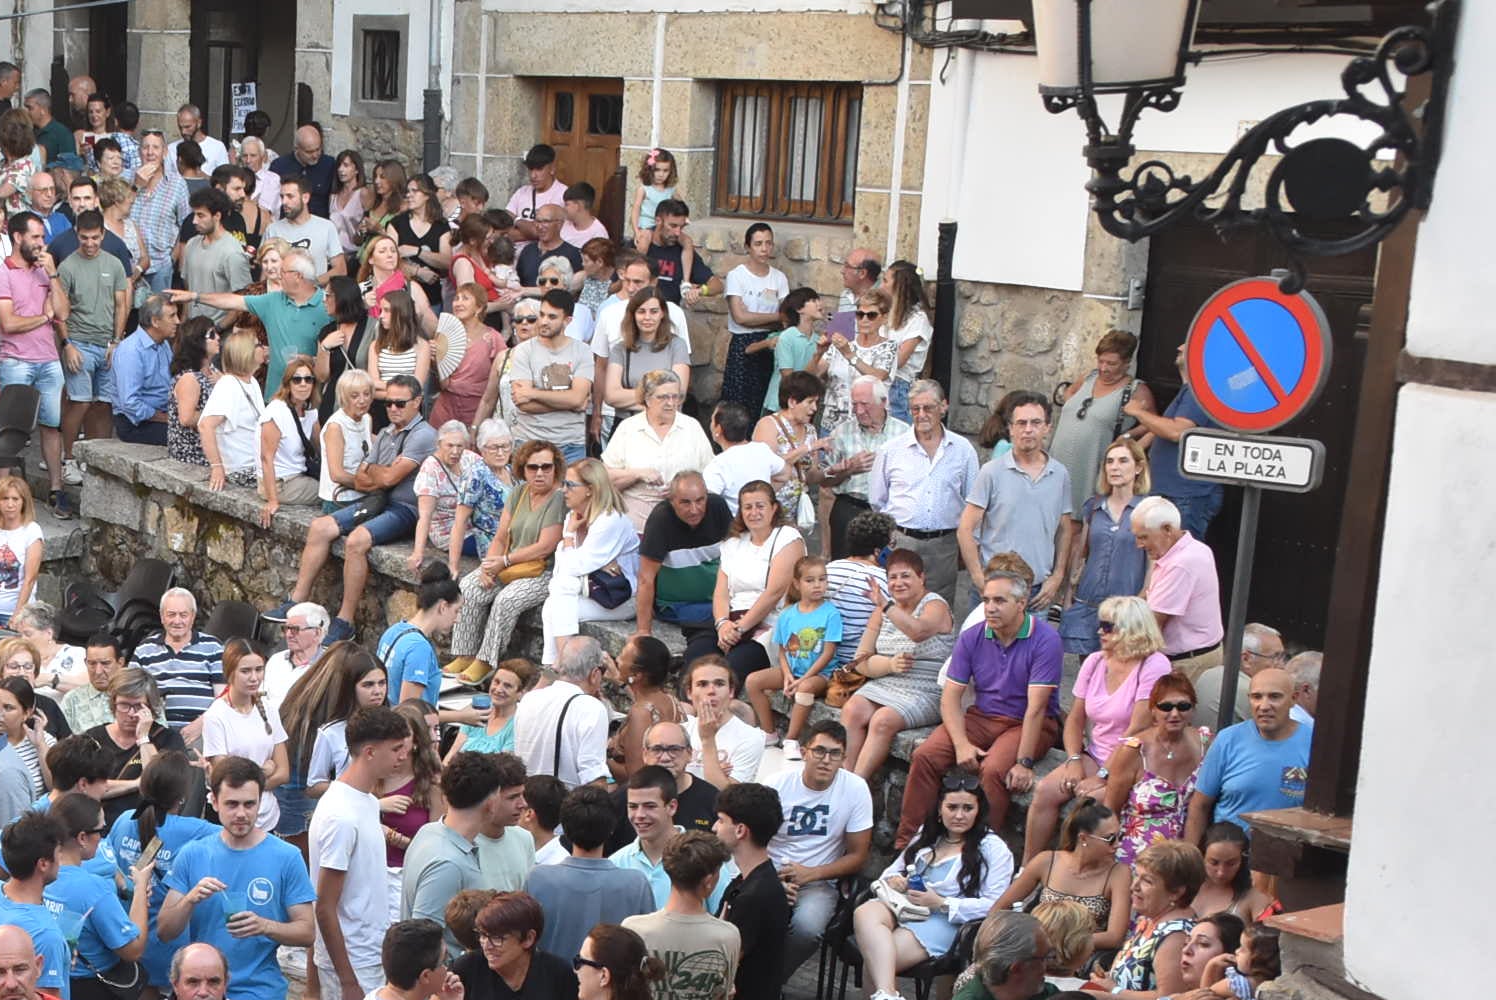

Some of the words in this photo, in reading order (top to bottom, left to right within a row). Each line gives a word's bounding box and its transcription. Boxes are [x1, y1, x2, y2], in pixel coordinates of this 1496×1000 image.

[1214, 443, 1235, 457] EN
[1242, 445, 1282, 462] TODA
[1207, 459, 1227, 472] LA
[1233, 461, 1286, 479] PLAZA
